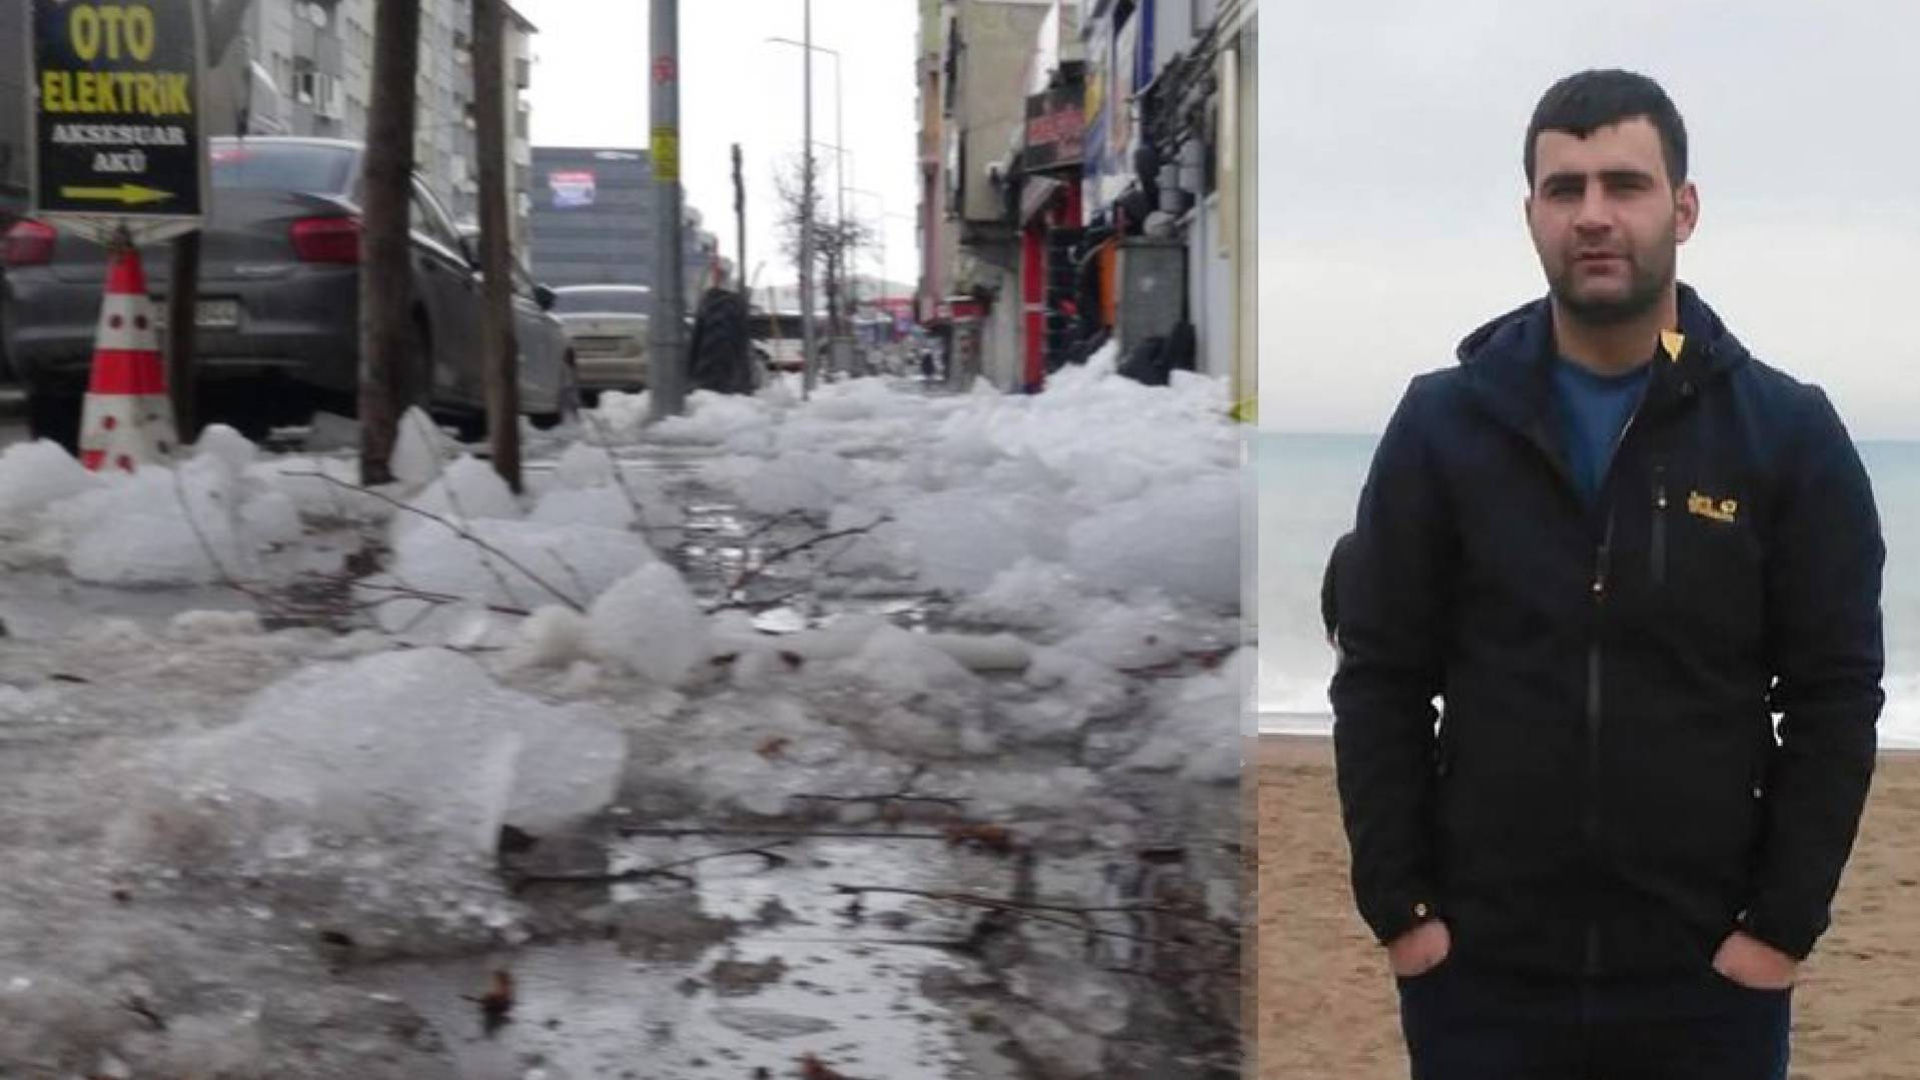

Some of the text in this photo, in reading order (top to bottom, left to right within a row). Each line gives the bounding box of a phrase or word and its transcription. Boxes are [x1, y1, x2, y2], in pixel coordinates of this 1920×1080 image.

[70, 4, 155, 62] OTO
[52, 123, 187, 146] AKSESUAR
[92, 149, 147, 174] AKÜ
